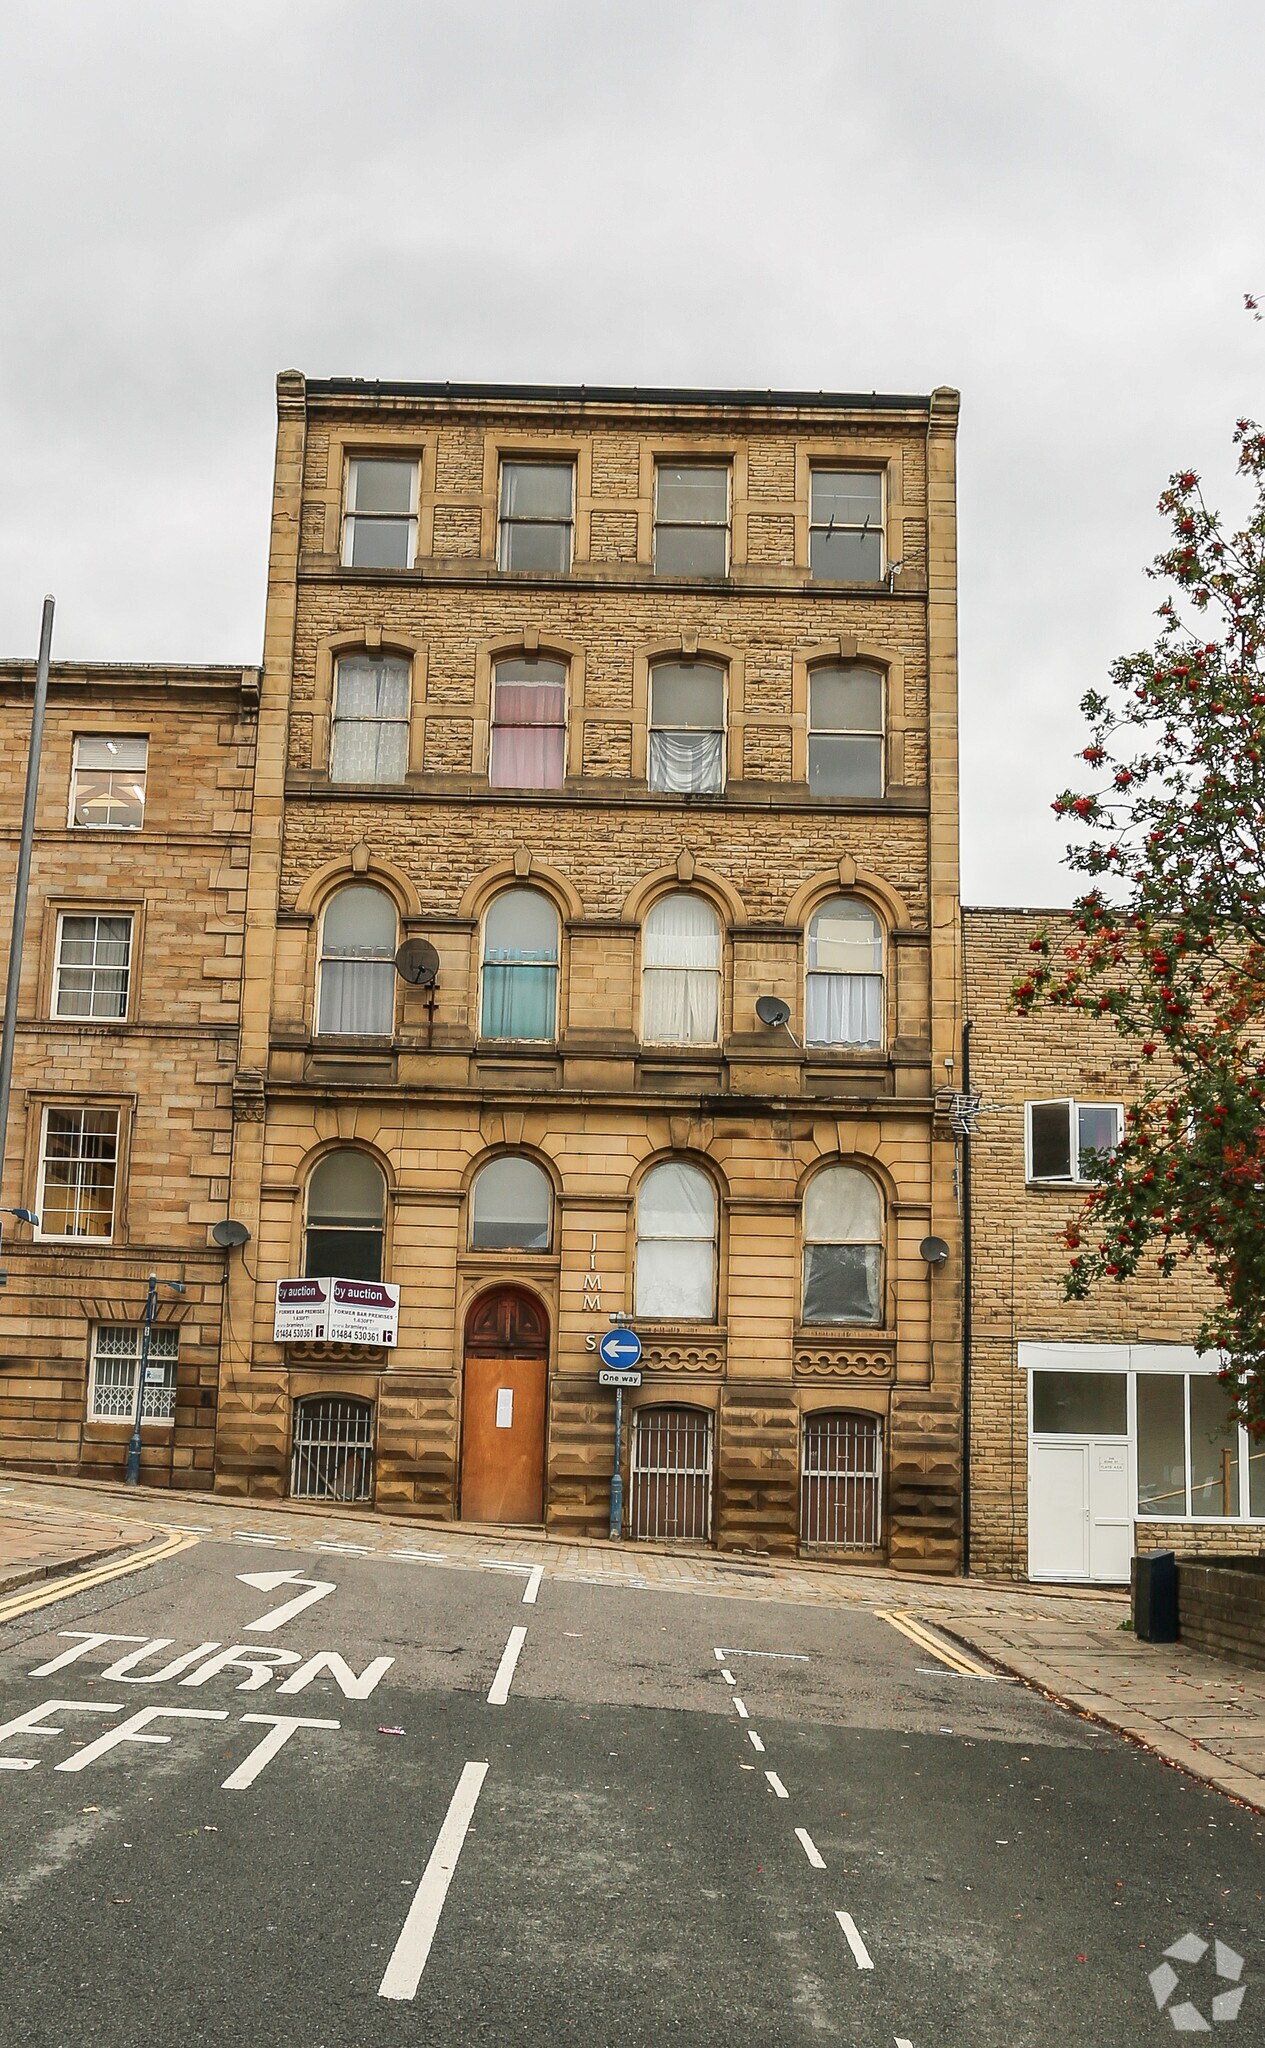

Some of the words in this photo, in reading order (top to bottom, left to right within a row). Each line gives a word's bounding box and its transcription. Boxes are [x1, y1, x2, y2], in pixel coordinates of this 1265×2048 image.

[288, 1285, 316, 1296] auction
[335, 1285, 346, 1299] by
[347, 1288, 383, 1301] auction
[368, 1312, 394, 1320] PREMISES
[275, 1329, 292, 1338] 01484
[293, 1329, 314, 1338] 530361
[331, 1329, 352, 1339] 01484
[354, 1330, 379, 1342] 530361
[602, 1373, 619, 1382] One
[621, 1376, 639, 1384] way
[28, 1631, 396, 1700] TURN
